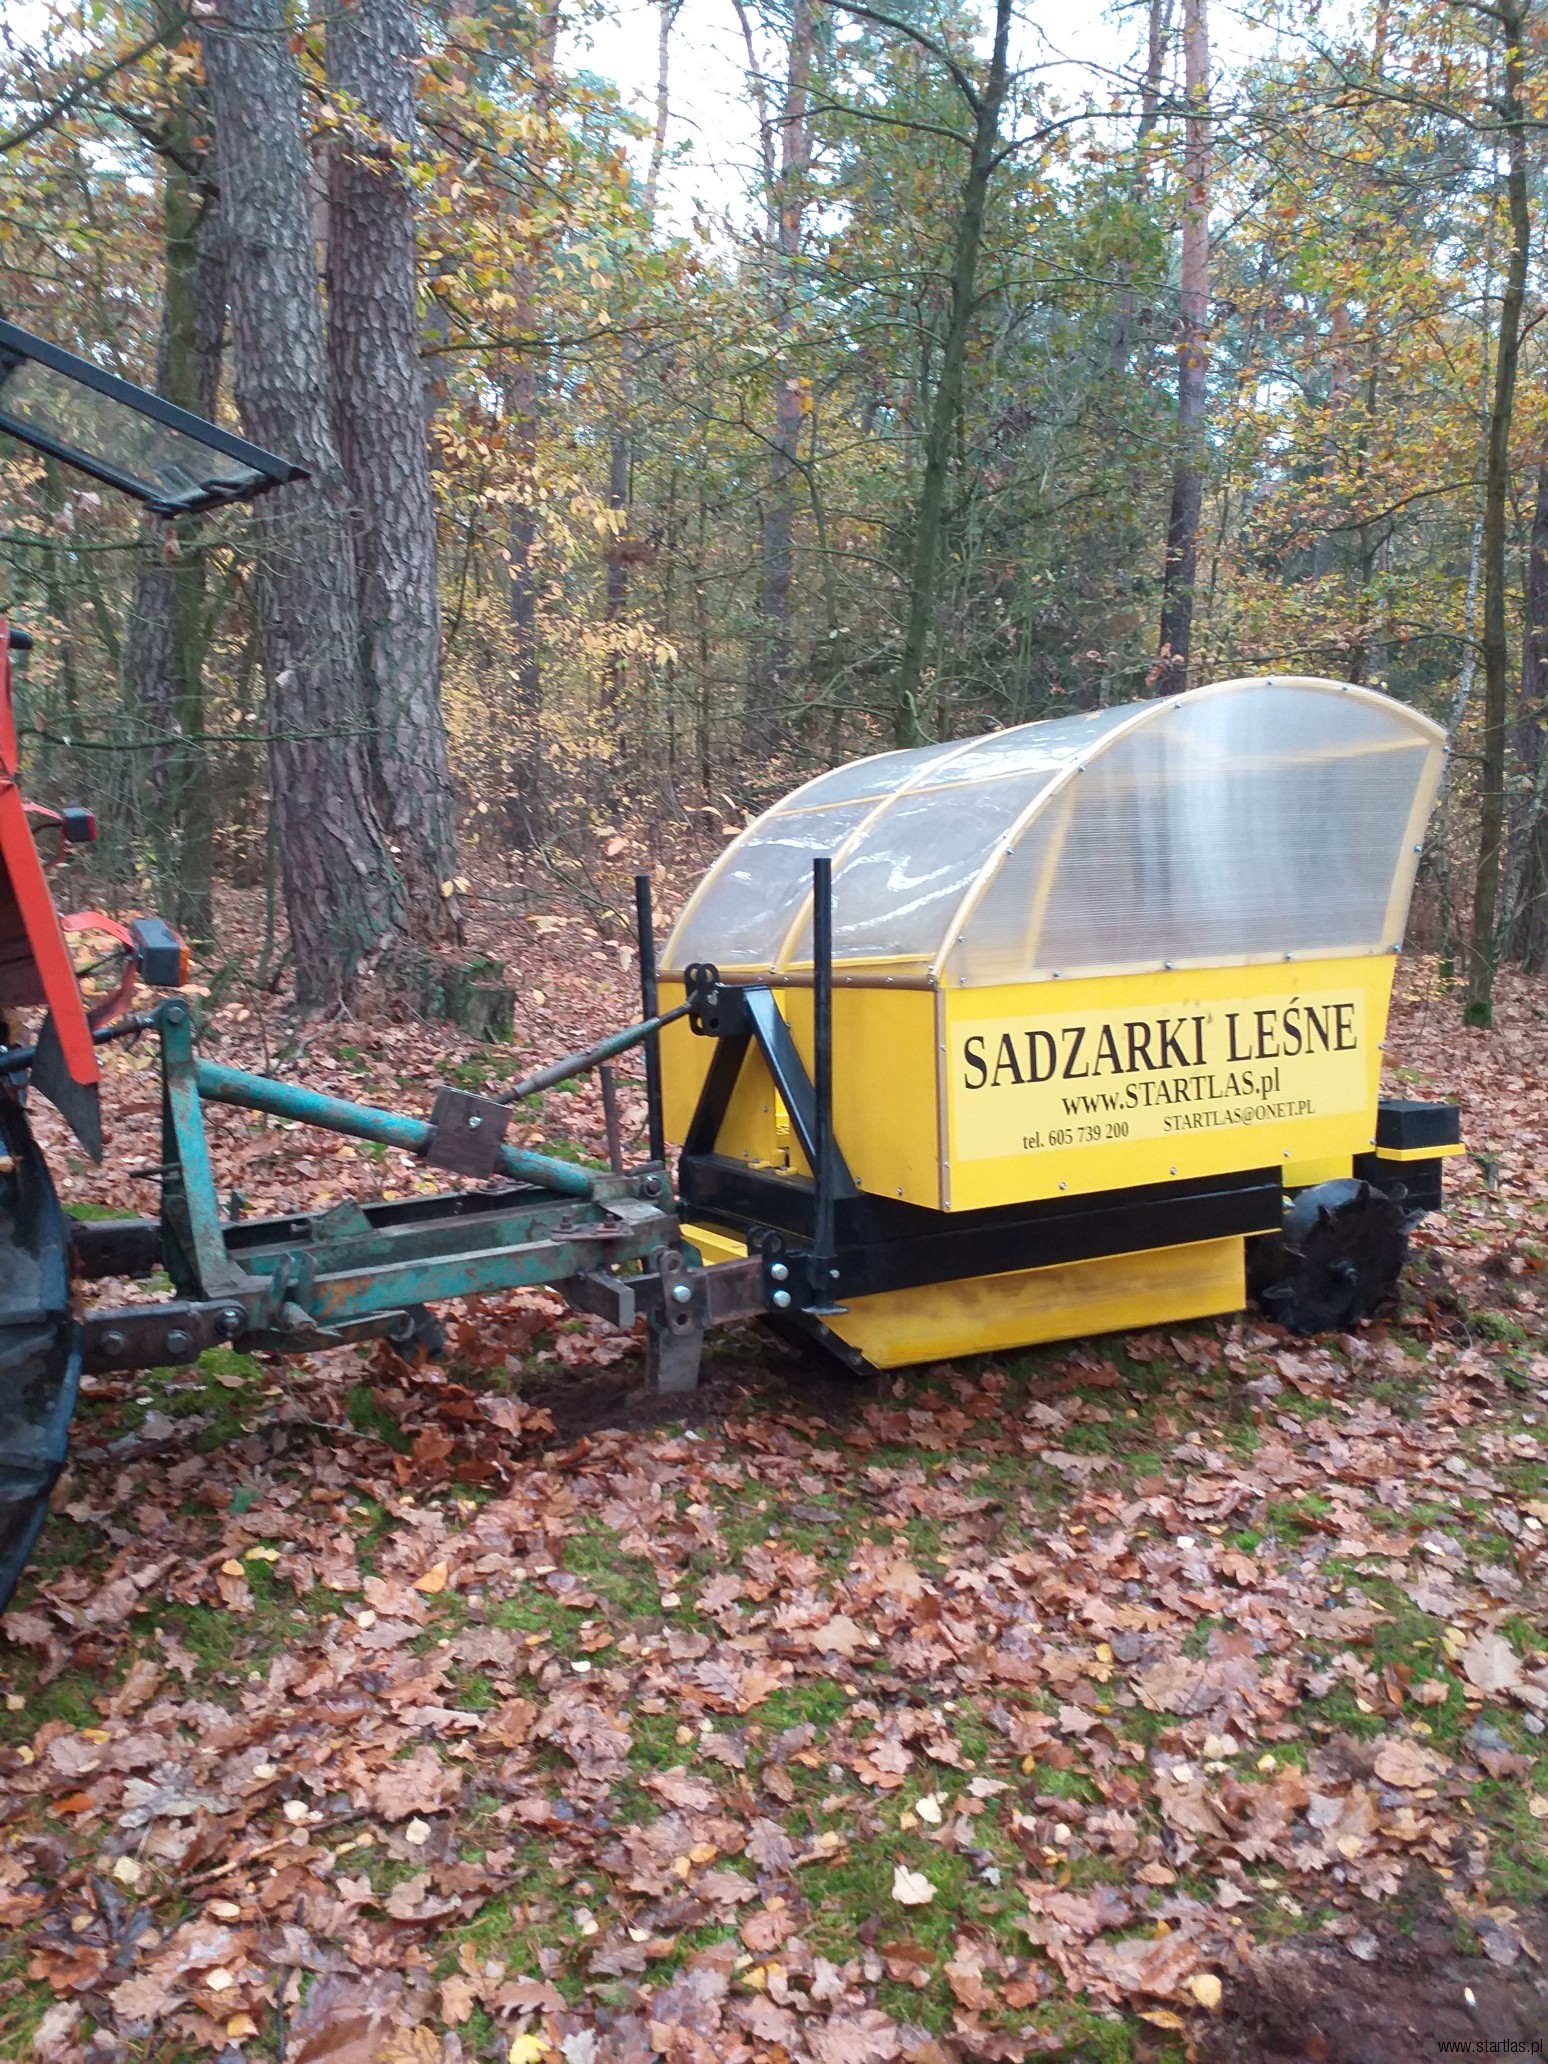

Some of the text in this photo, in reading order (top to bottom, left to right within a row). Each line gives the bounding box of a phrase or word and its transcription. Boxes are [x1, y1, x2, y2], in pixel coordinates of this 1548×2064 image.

[963, 997, 1358, 1090] SADZARKI LEŚNE
[1062, 1066, 1281, 1116] www.STARTLAS.pl
[1022, 1121, 1129, 1150] tel. 605 739 200
[1163, 1099, 1315, 1132] STARTLAS@ONET.PL
